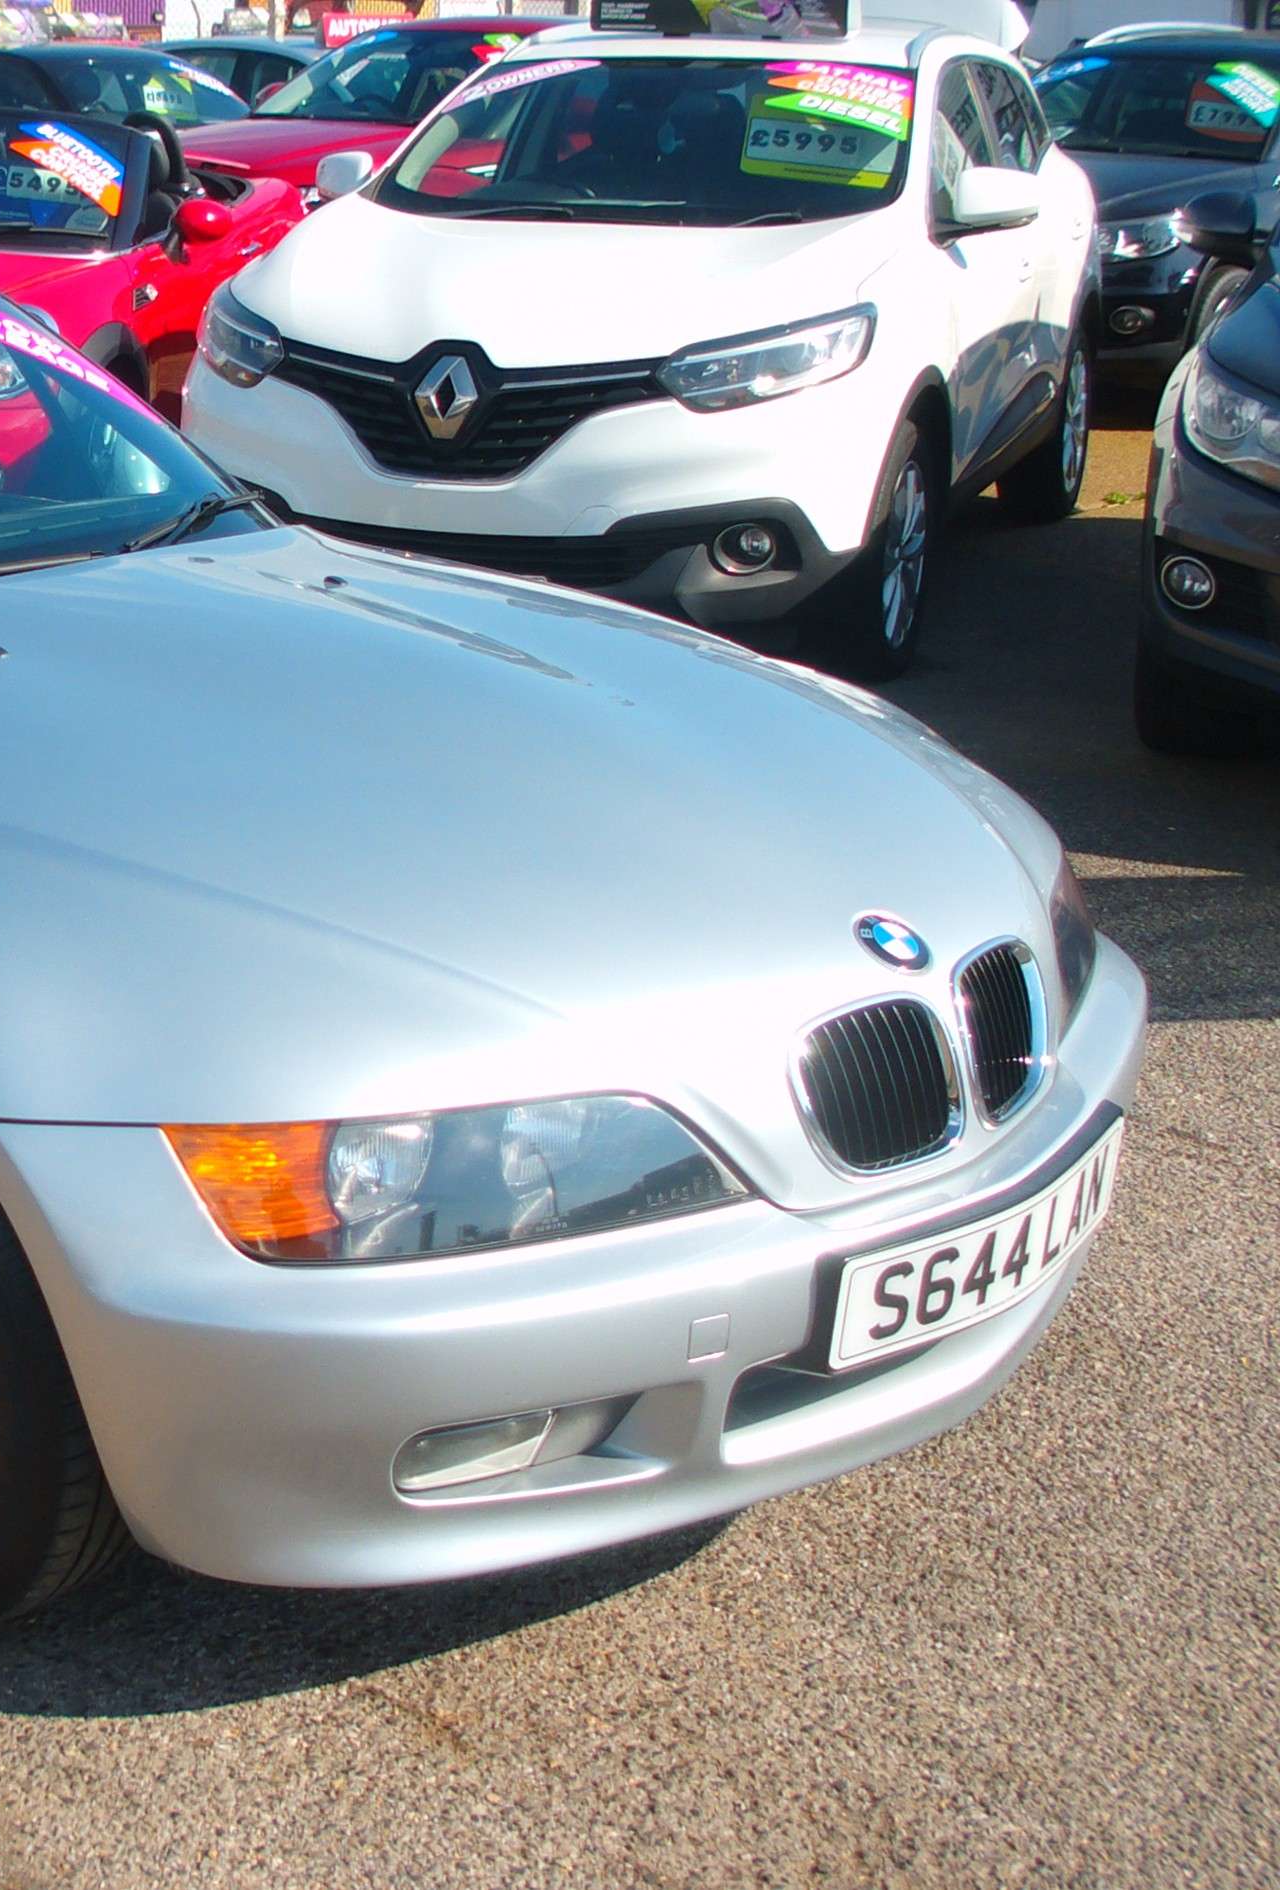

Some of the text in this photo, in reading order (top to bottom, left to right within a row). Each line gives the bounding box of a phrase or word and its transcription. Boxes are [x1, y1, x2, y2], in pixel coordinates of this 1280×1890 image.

[488, 61, 577, 93] OWNERS
[795, 62, 909, 92] SAT NAV
[798, 94, 903, 134] DIESEL
[36, 123, 121, 181] BLUETOOTH
[749, 129, 859, 156] £5995
[868, 1143, 1110, 1341] S644 LAN
